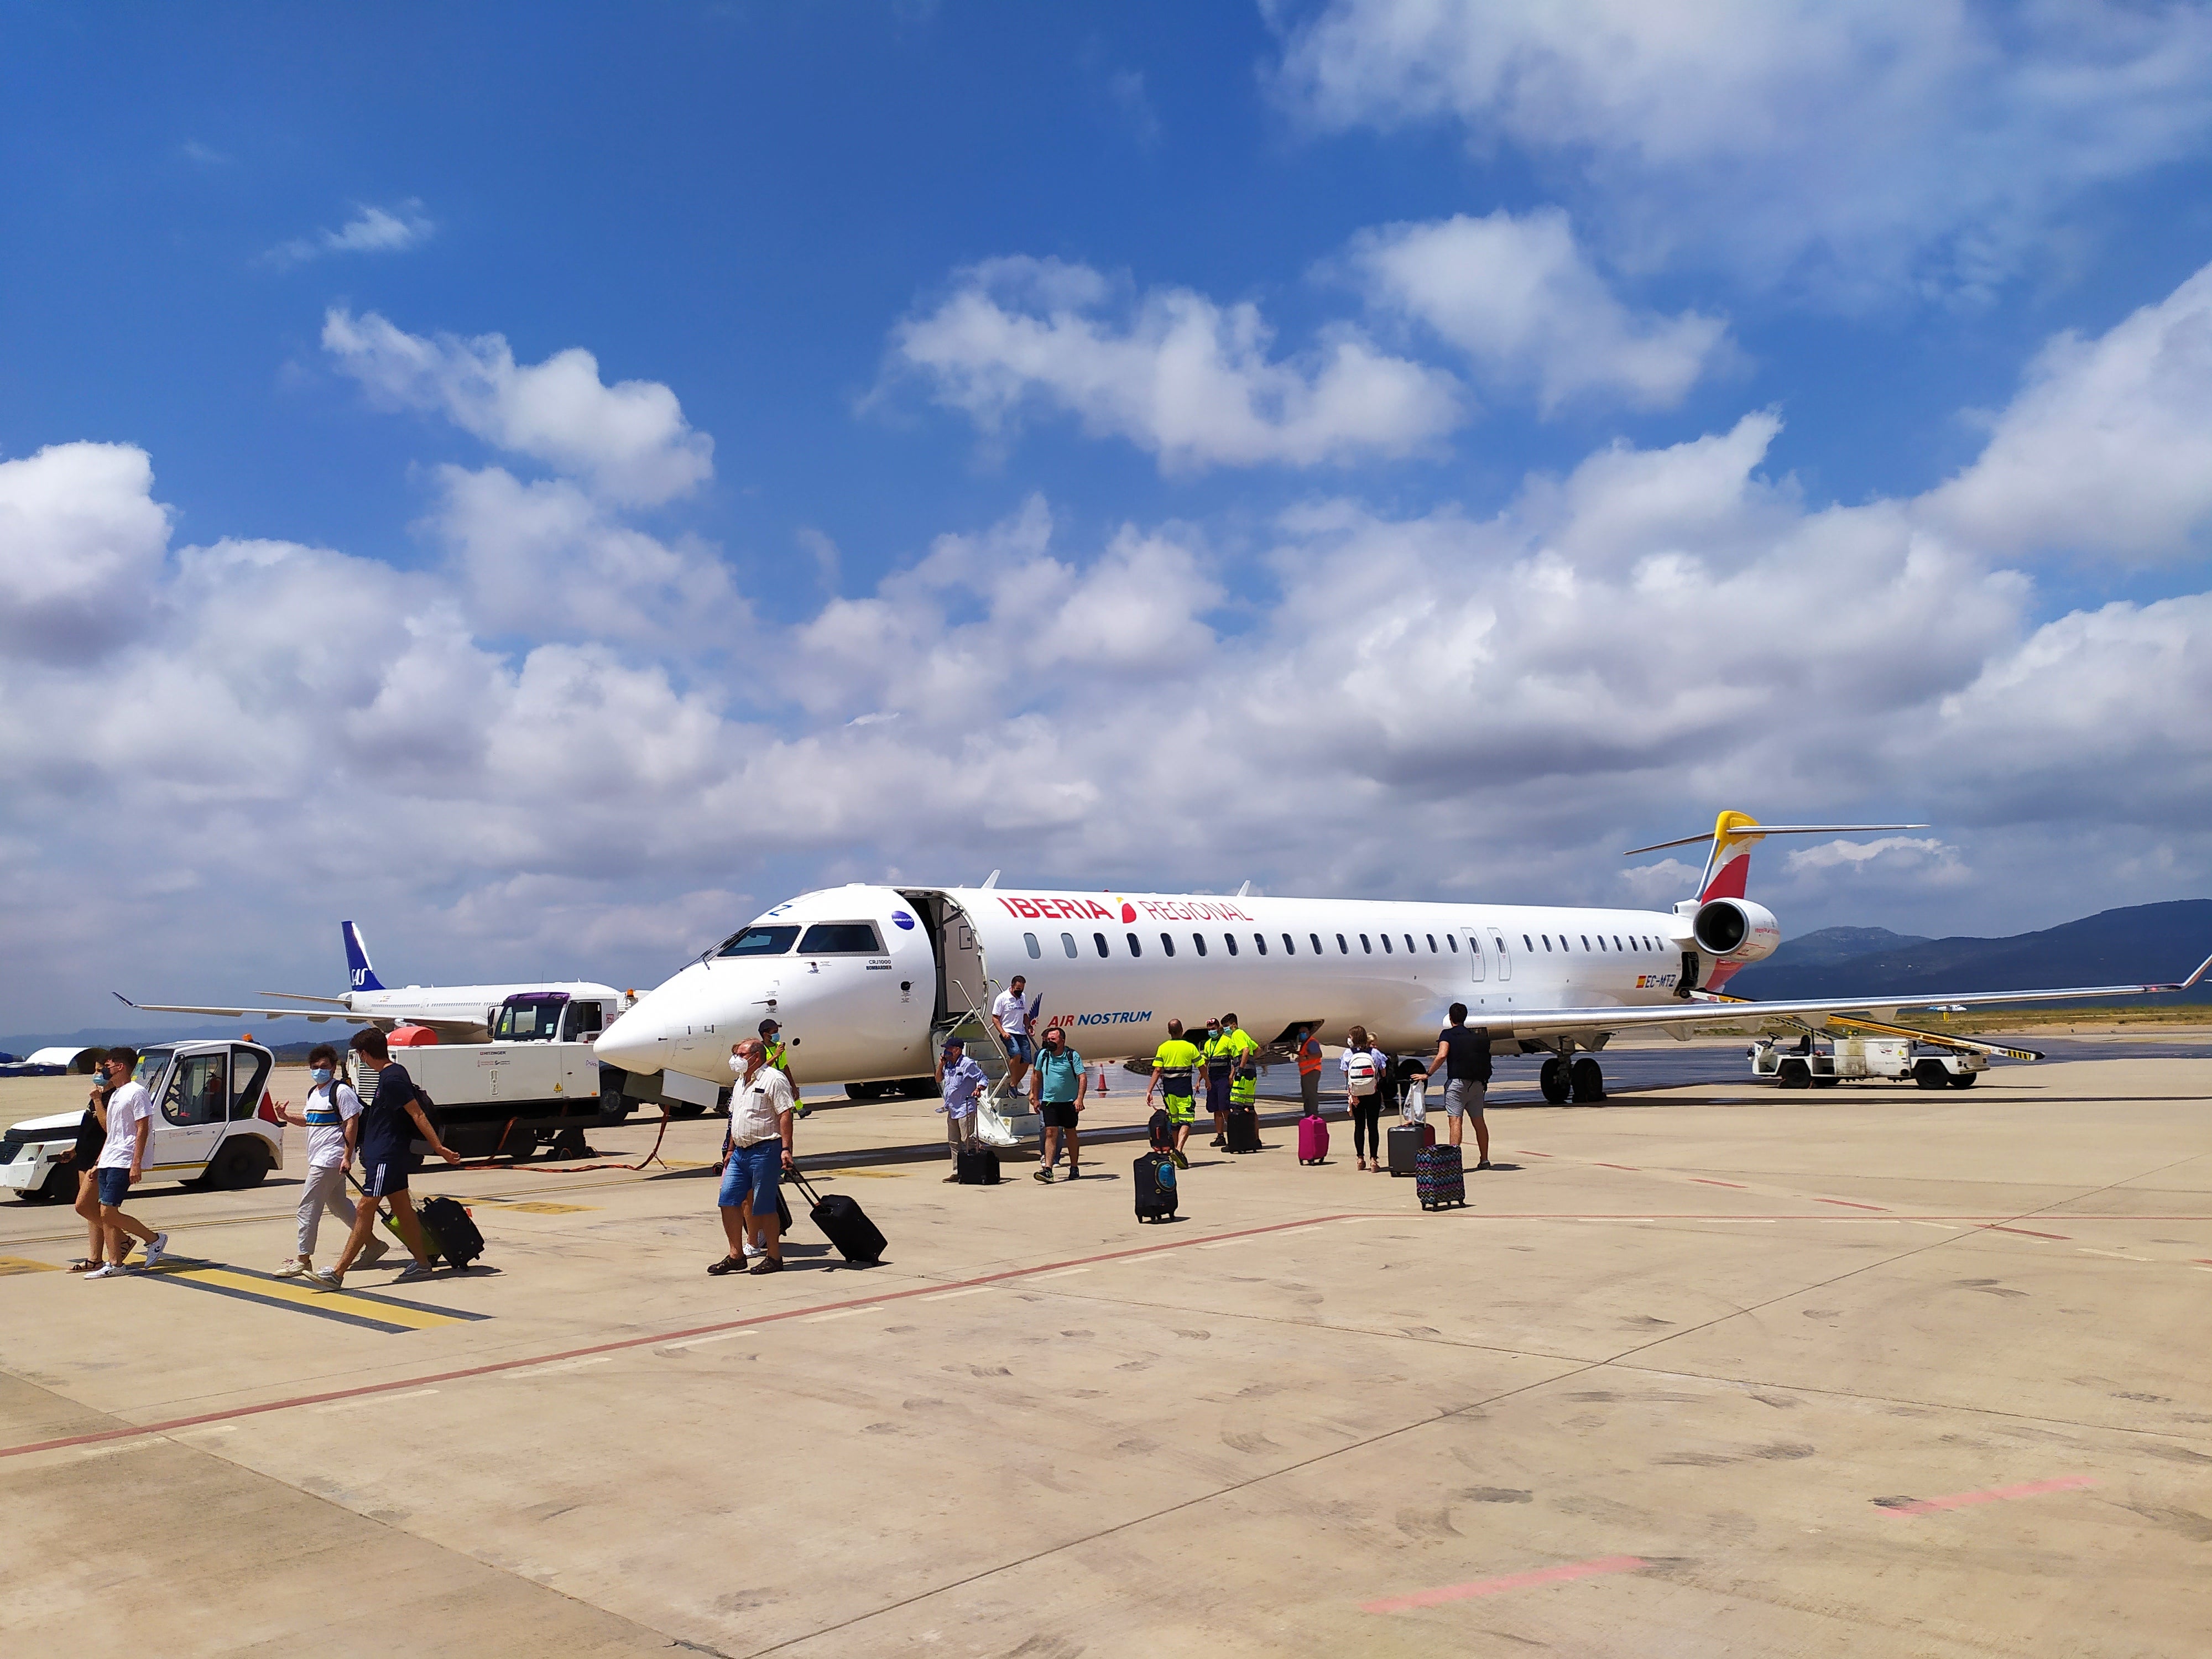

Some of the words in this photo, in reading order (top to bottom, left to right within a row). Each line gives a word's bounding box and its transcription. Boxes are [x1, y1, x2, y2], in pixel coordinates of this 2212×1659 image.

[996, 898, 1115, 919] IBERIA
[1137, 901, 1254, 921] REGIONAL
[352, 968, 368, 986] SAS
[1645, 974, 1677, 988] EC-MTZ
[1047, 1015, 1074, 1027] AIR
[1077, 1011, 1152, 1026] NOSTRUM
